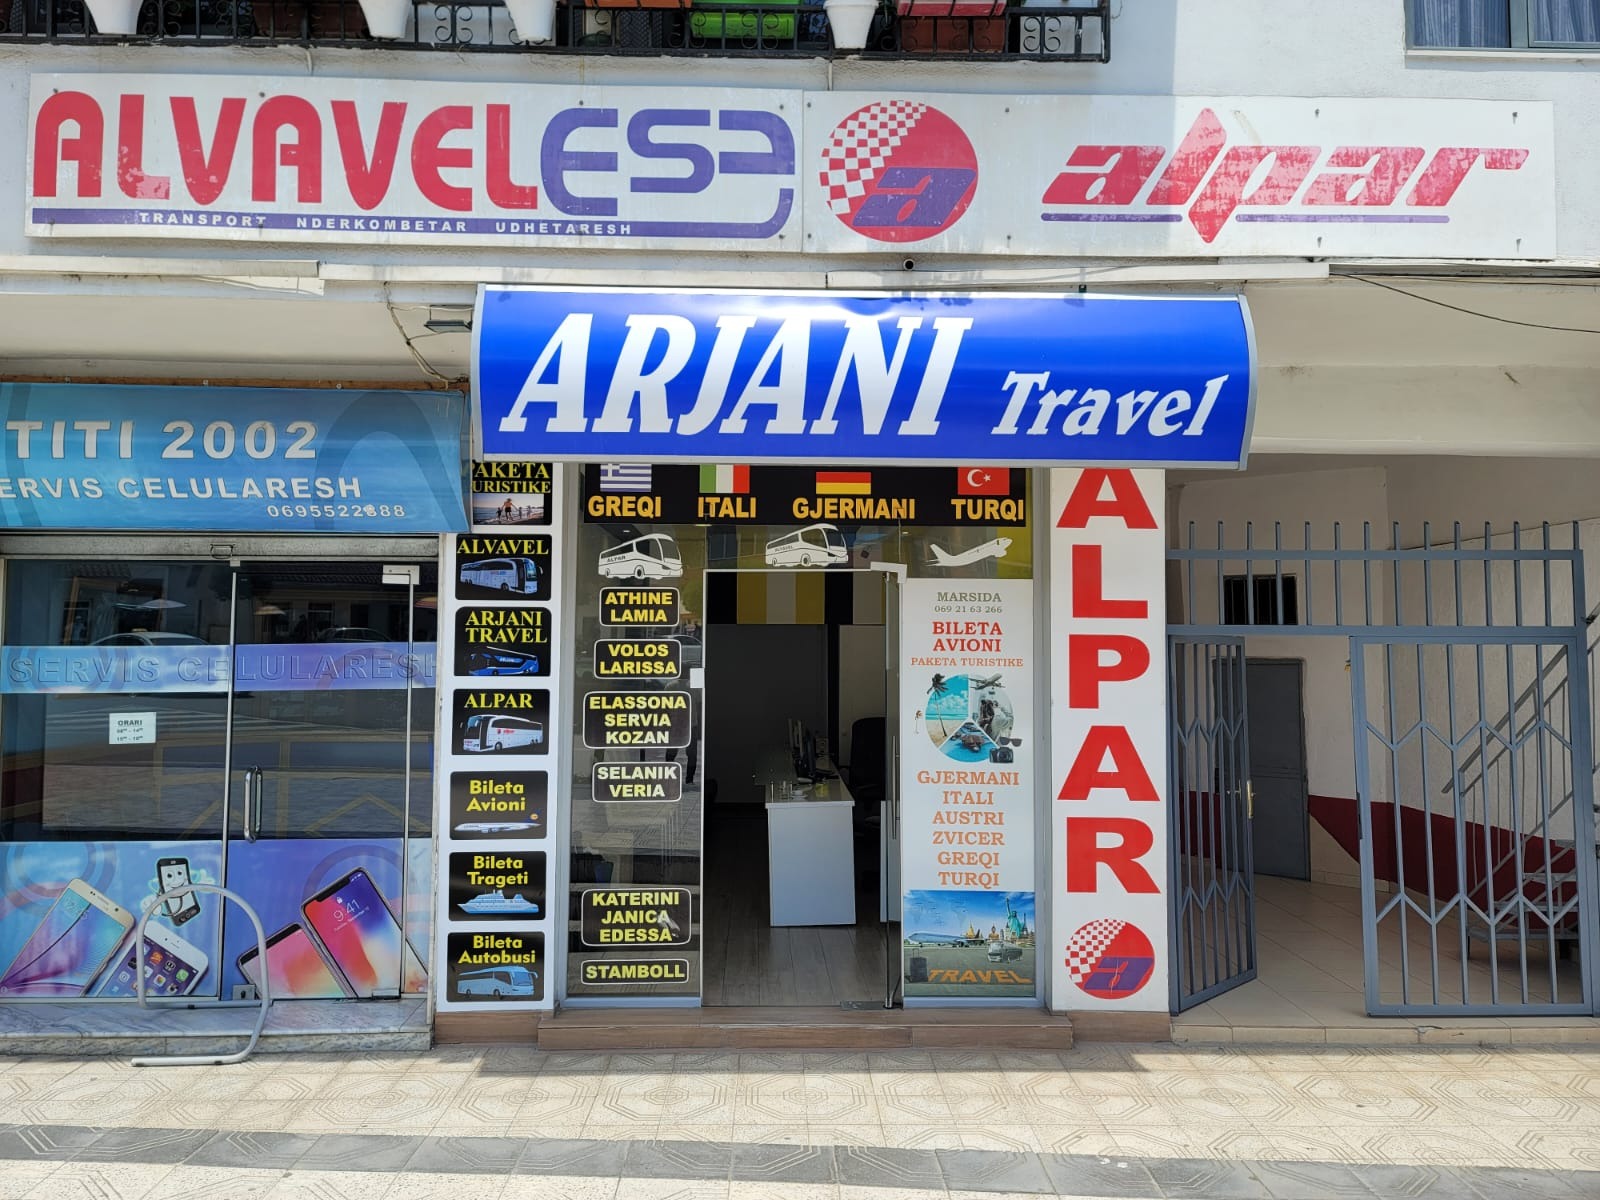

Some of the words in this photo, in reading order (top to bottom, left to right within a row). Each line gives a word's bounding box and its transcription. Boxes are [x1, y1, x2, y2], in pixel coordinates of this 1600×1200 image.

[33, 91, 537, 211] ALVAVEL
[139, 211, 267, 227] TRANSPORT
[296, 217, 468, 232] NDERKOMBETAR
[495, 222, 633, 235] UDHETARESH
[499, 312, 974, 436] ARJANI
[991, 372, 1229, 437] Travel
[5, 420, 136, 459] TITI
[161, 420, 318, 459] 2002
[473, 462, 549, 479] AKETA
[0, 477, 103, 499] ERVIS
[119, 477, 362, 499] CELULARESH
[472, 481, 551, 494] URISTIKE
[588, 495, 662, 518] GREQI
[697, 496, 757, 518] ITALI
[792, 497, 916, 520] GJERMANI
[951, 498, 1024, 521] TURQI
[457, 539, 549, 555] ALVAVEL
[605, 592, 673, 605] ATHINE
[937, 592, 1002, 602] MARSIDA
[610, 609, 668, 622] LAMIA
[934, 605, 953, 613] 069
[955, 605, 967, 613] 21
[970, 605, 982, 613] 63
[465, 611, 542, 626] ARJANI
[932, 621, 1003, 635] BILETA
[465, 628, 547, 643] TRAVEL
[608, 644, 669, 657] VOLOS
[932, 638, 1002, 652] AVIONI
[600, 661, 677, 674] LARISSA
[911, 657, 957, 666] PAKETA
[960, 658, 1024, 667] TURISTIKE
[9, 656, 161, 683] SERVIS
[1057, 468, 1161, 894] ALPAR
[464, 693, 533, 709] ALPAR
[589, 696, 687, 709] ELASSONA
[604, 713, 671, 727] SERVIA
[606, 731, 669, 745] KOZAN
[597, 766, 677, 780] SELANIK
[917, 771, 1020, 786] GJERMANI
[469, 780, 524, 795] Bileta
[609, 784, 665, 798] VERIA
[466, 798, 526, 812] Avioni
[942, 791, 994, 805] ITALI
[932, 811, 1004, 826] AUSTRI
[932, 831, 1005, 846] ZVICER
[473, 856, 523, 869] Bileta
[937, 852, 1000, 869] GREQI
[467, 872, 528, 888] Trageti
[938, 871, 1000, 889] TURQI
[592, 892, 679, 906] KATERINI
[601, 910, 671, 924] JANICA
[473, 935, 523, 949] Bileta
[599, 928, 672, 942] EDESSA
[458, 950, 536, 964] Autobusi
[585, 965, 685, 979] STAMBOLL
[927, 969, 1033, 984] TRAVEL
